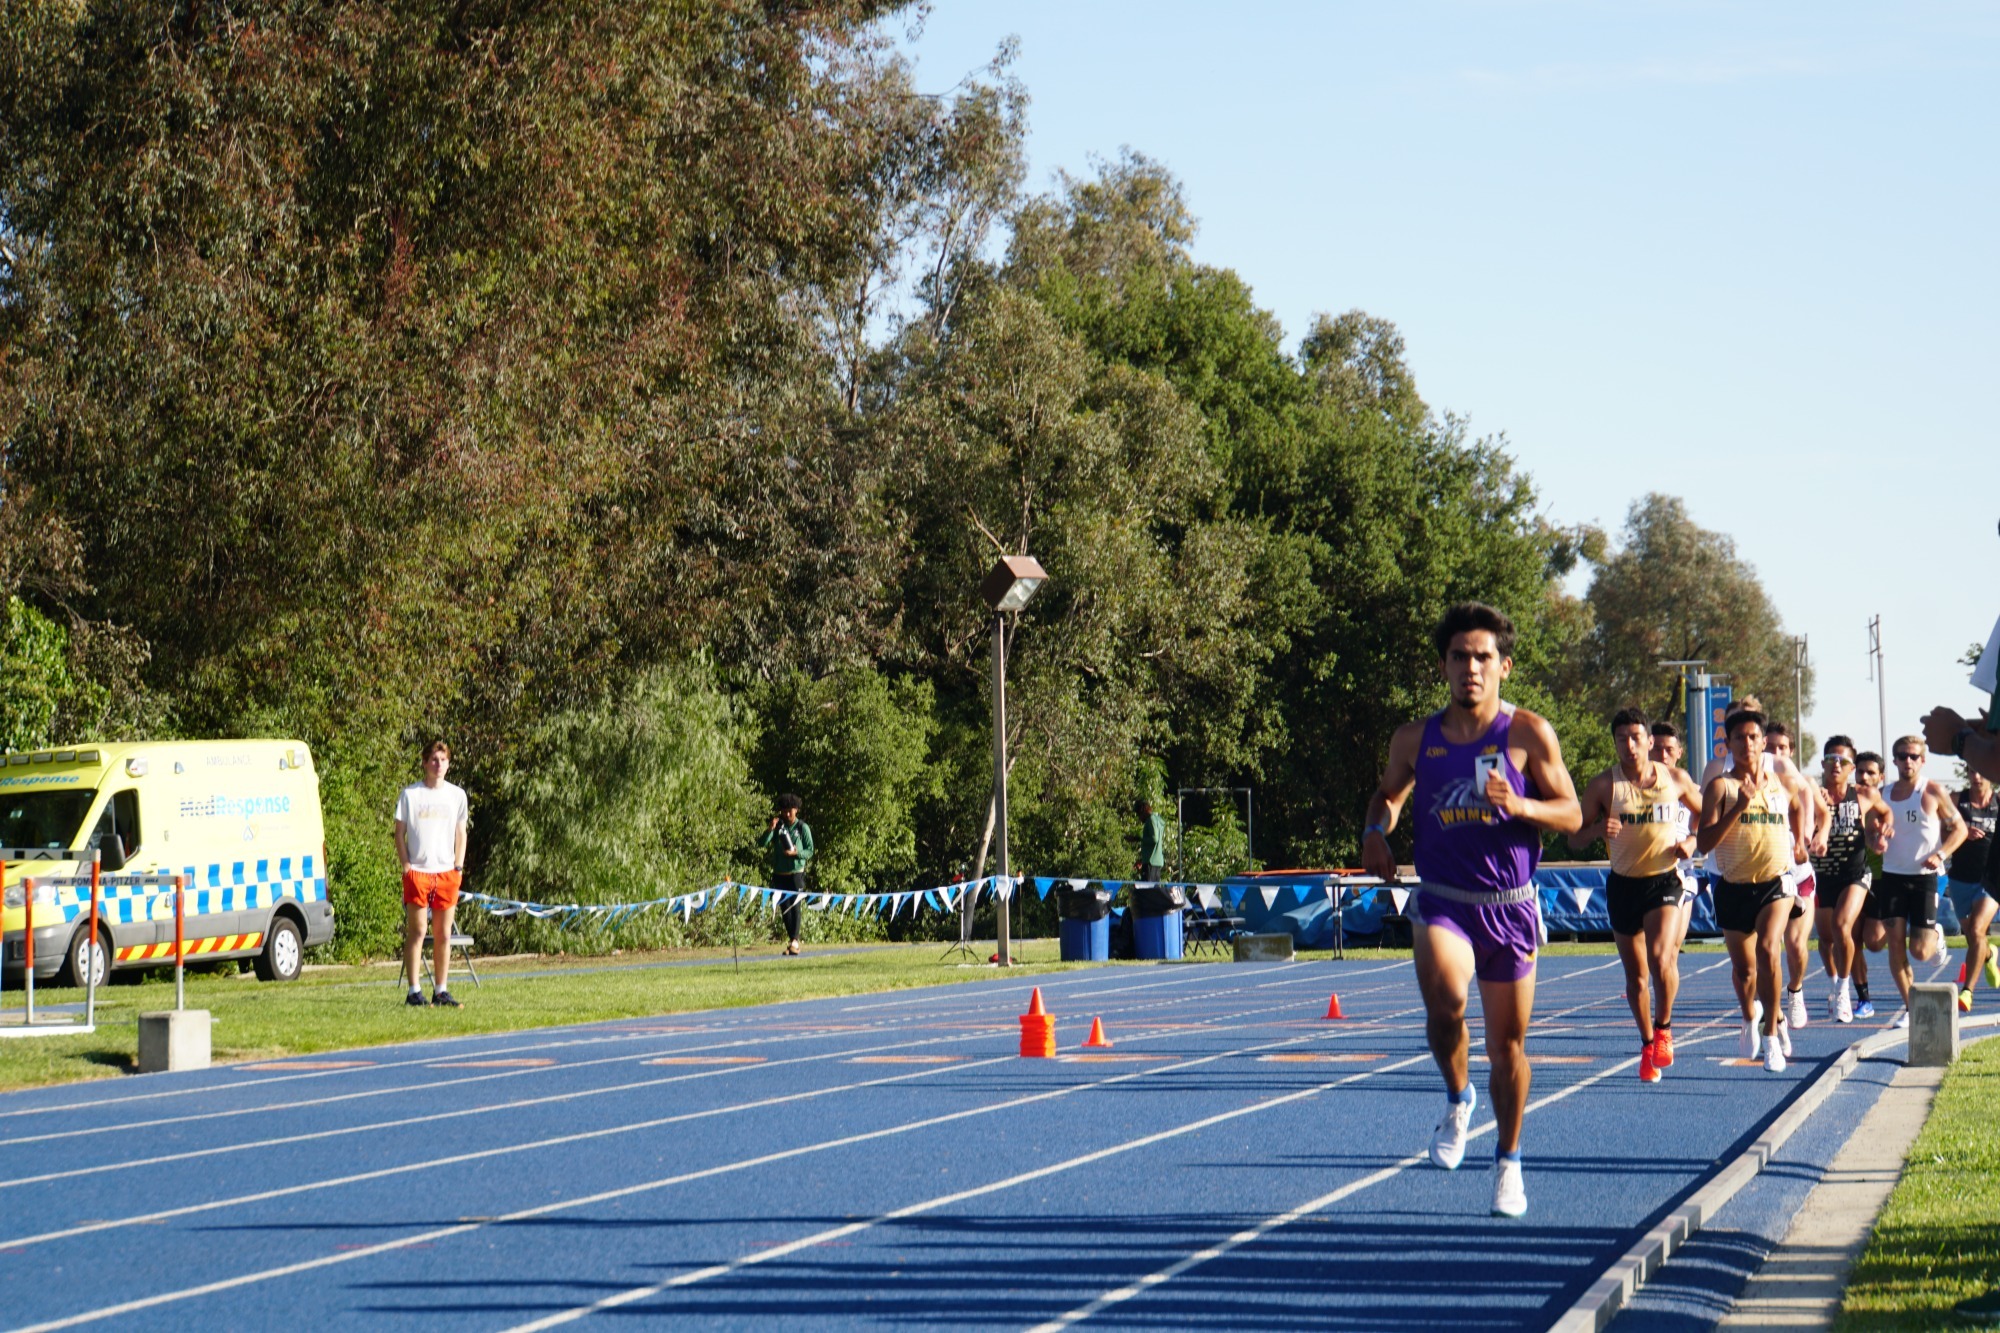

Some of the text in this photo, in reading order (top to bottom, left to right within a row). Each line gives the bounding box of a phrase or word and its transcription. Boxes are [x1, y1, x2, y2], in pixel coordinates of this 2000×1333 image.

[1440, 807, 1492, 826] WNMU
[1657, 805, 1670, 820] 11
[1906, 810, 1917, 822] 15
[1739, 813, 1784, 825] OMONA
[71, 876, 140, 886] POMA-PITZER
